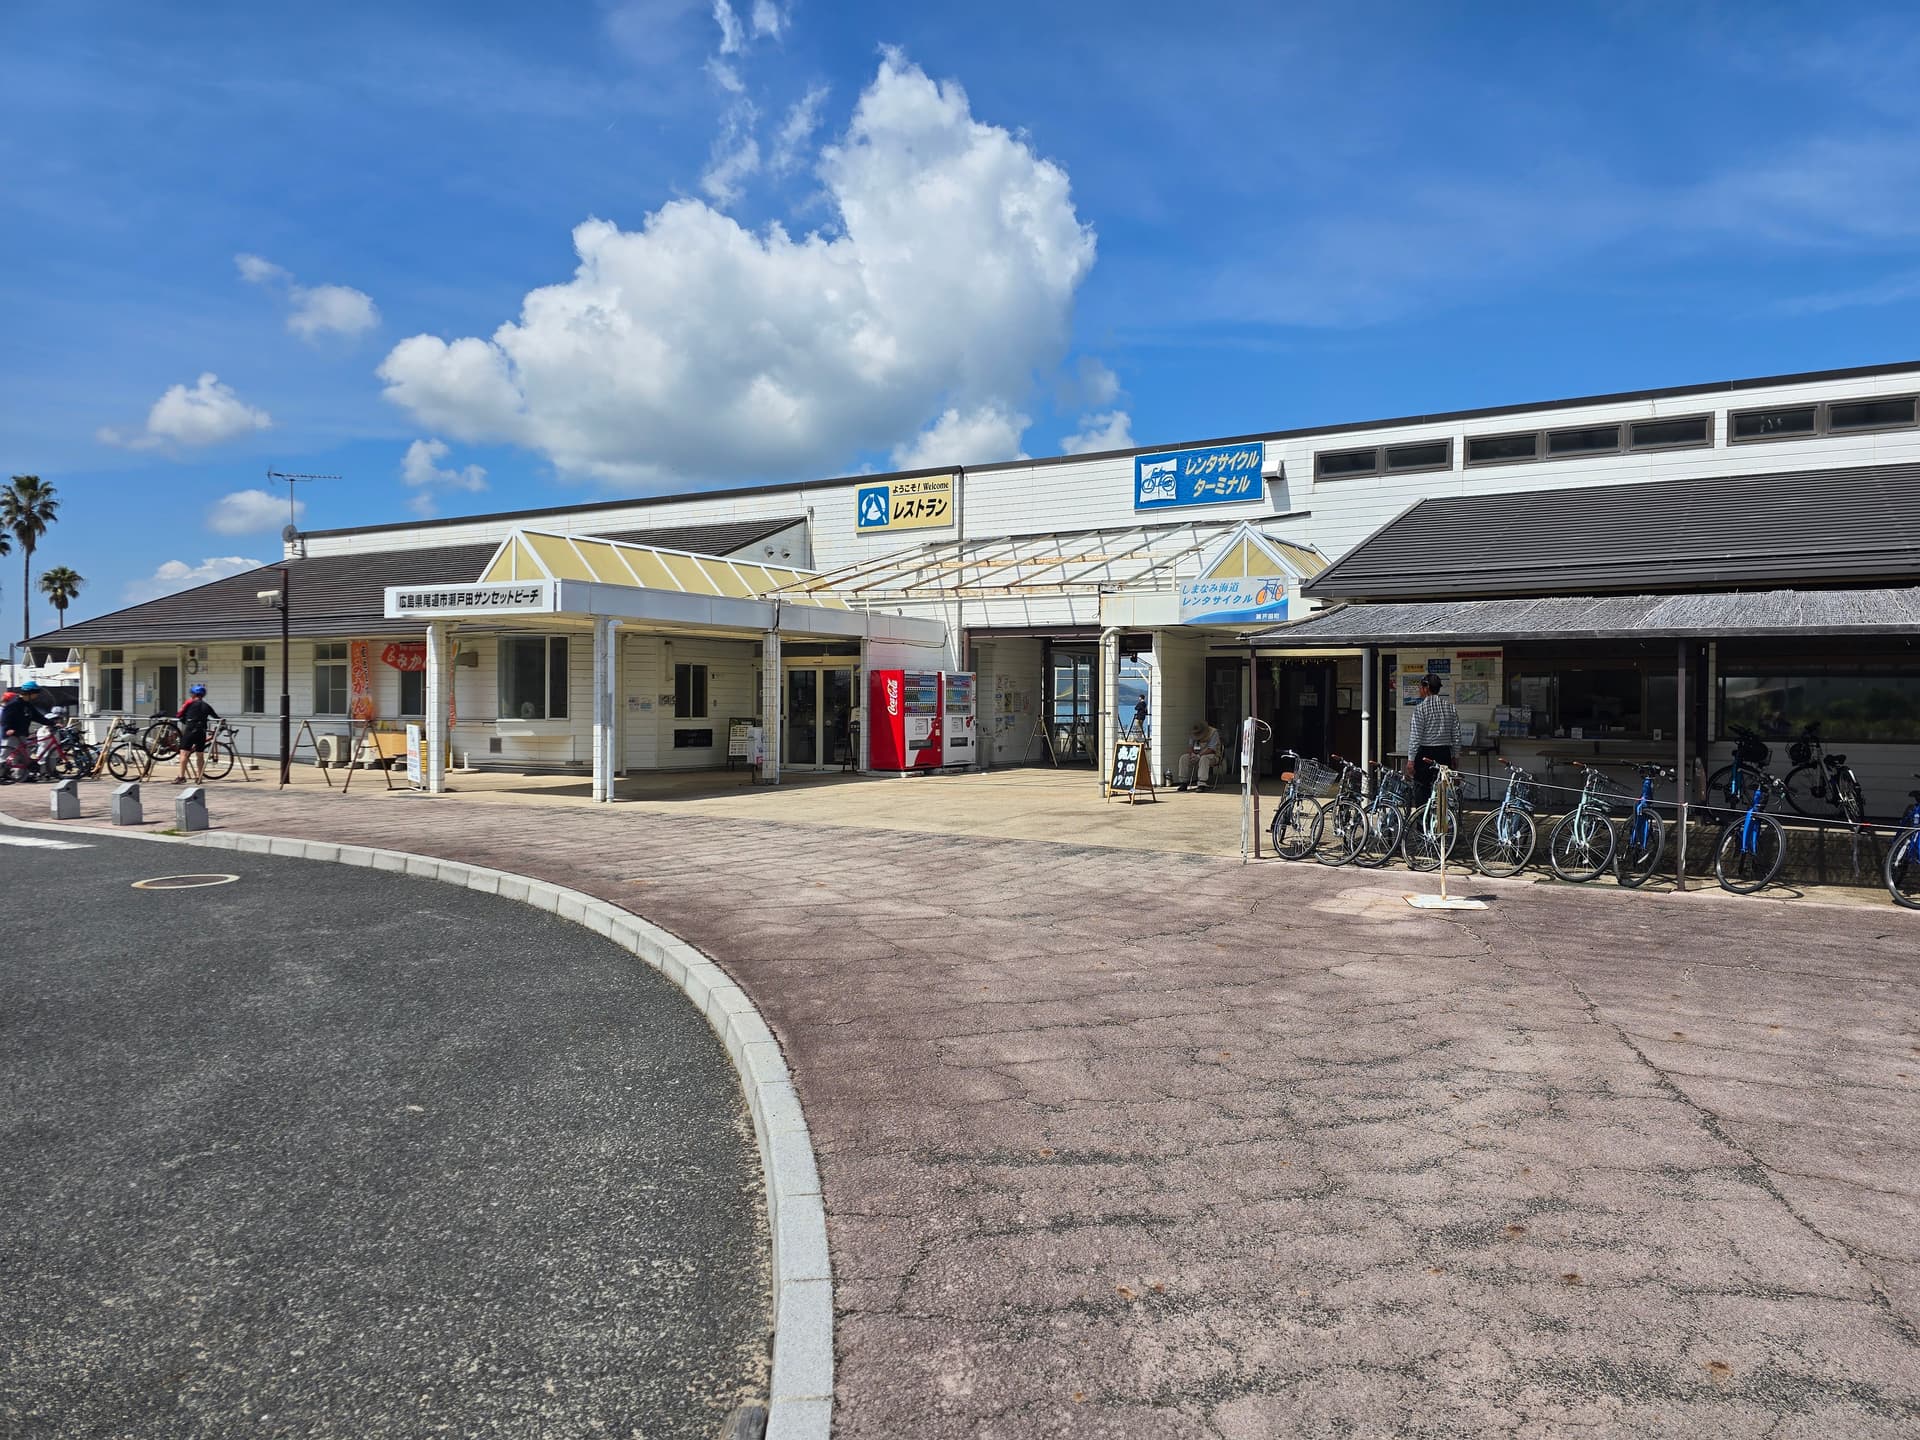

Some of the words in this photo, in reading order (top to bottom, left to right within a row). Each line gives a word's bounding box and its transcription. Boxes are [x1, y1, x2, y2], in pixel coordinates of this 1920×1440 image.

[1185, 450, 1260, 475] レンタサイクル
[923, 481, 949, 491] Welcome
[1193, 475, 1251, 497] ターミナル
[893, 498, 948, 520] レストラン
[399, 588, 539, 609] 広島県尾道市瀬戸田サンセットビーチ
[1183, 581, 1240, 595] しまなみ海道
[1183, 594, 1253, 607] レンタサイクル
